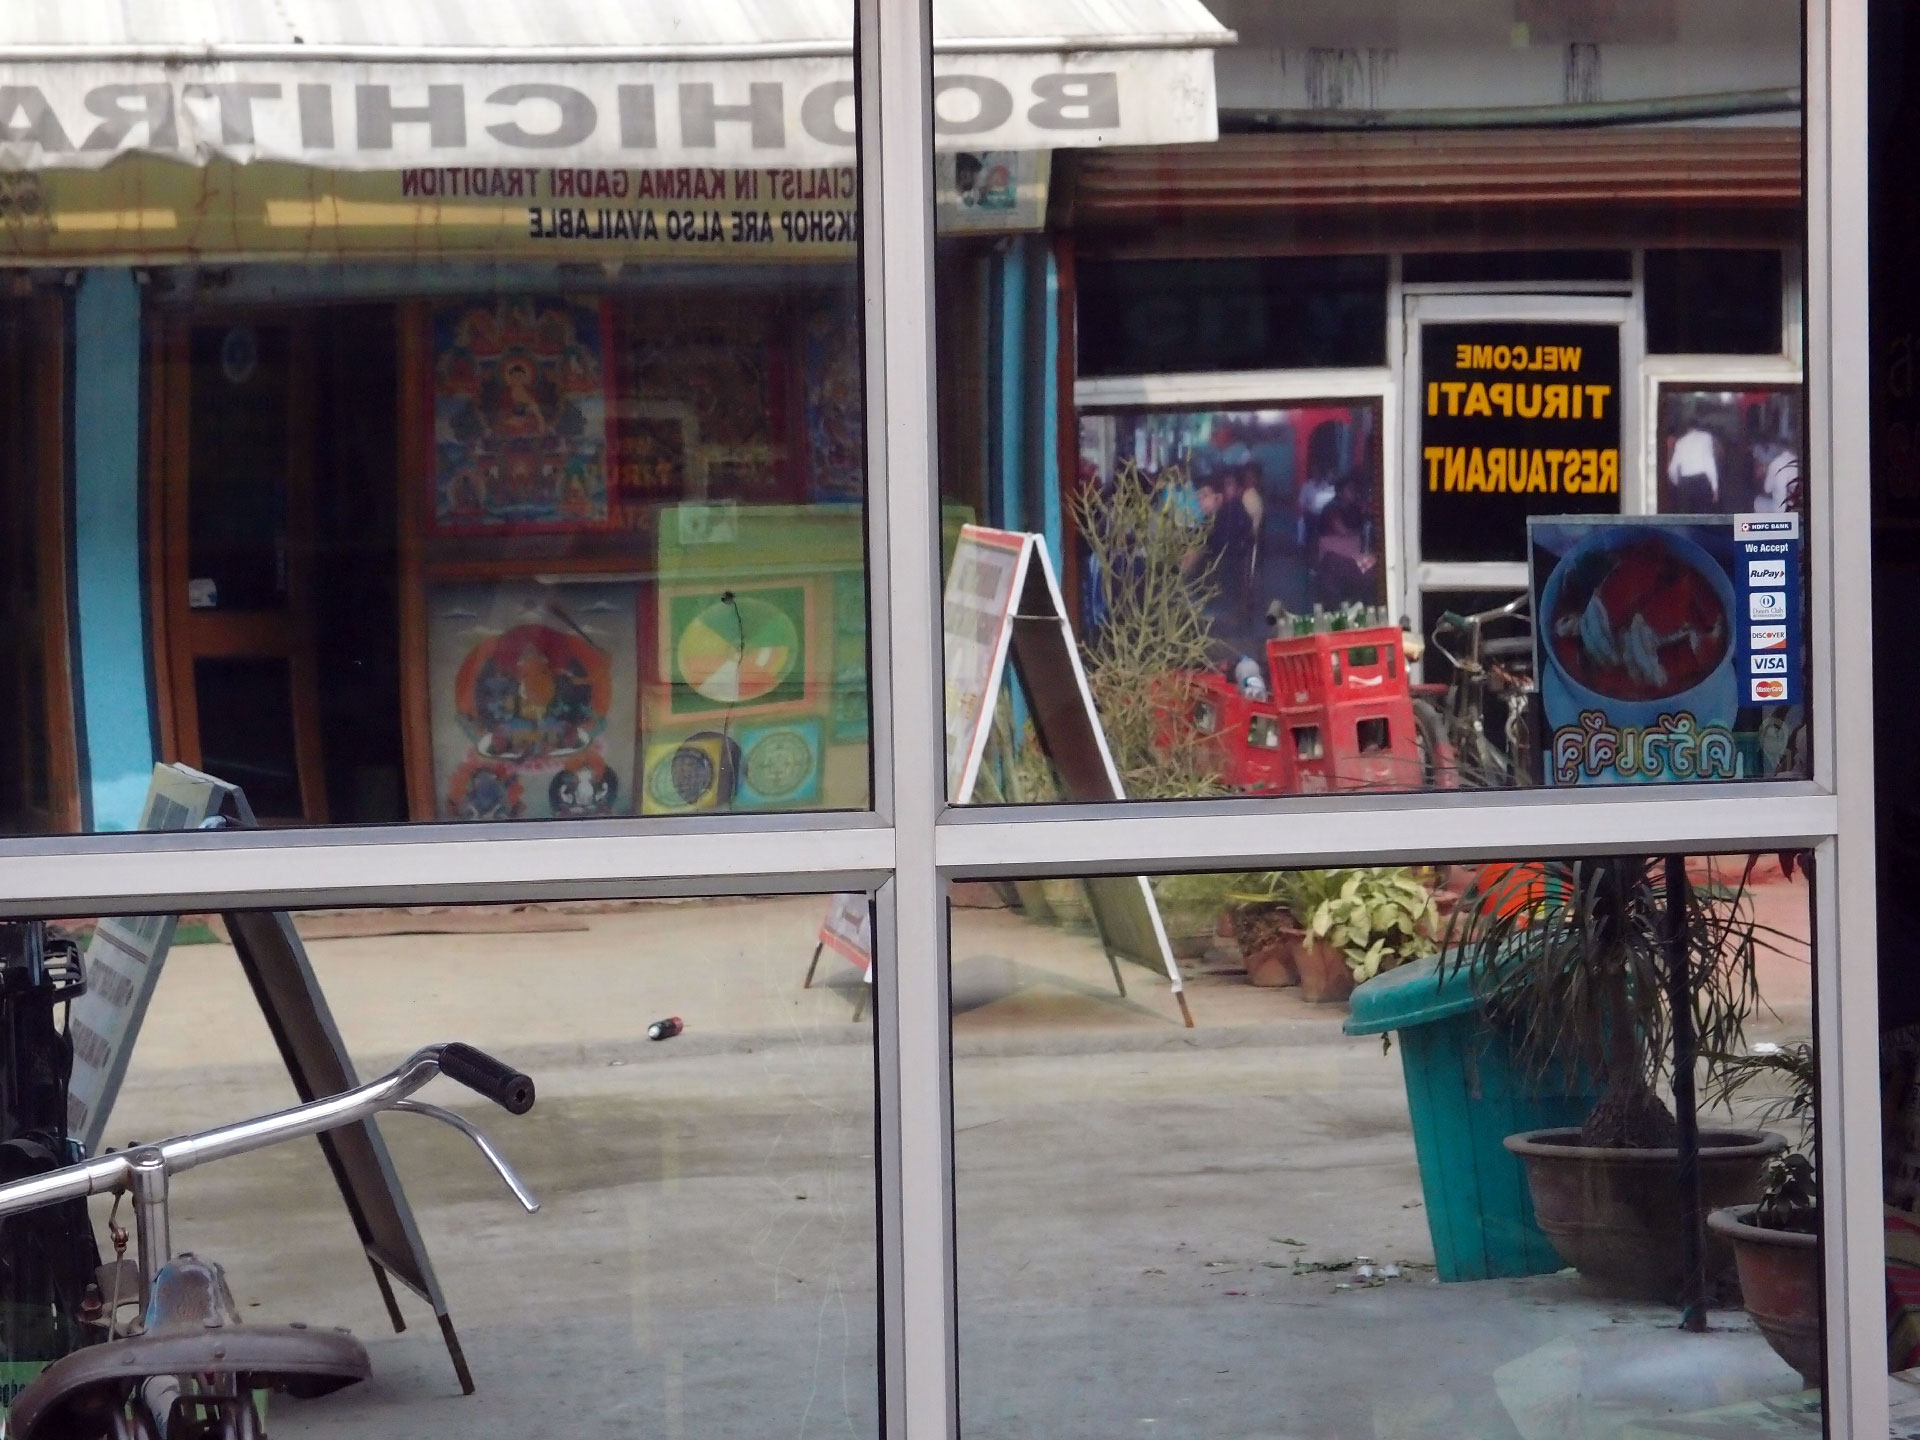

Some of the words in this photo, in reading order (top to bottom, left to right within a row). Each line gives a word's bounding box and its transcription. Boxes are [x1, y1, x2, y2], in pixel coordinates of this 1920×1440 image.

[1745, 543, 1758, 553] We
[1760, 542, 1789, 554] Accept
[1750, 569, 1780, 579] RuPay
[1754, 657, 1785, 670] VISA
